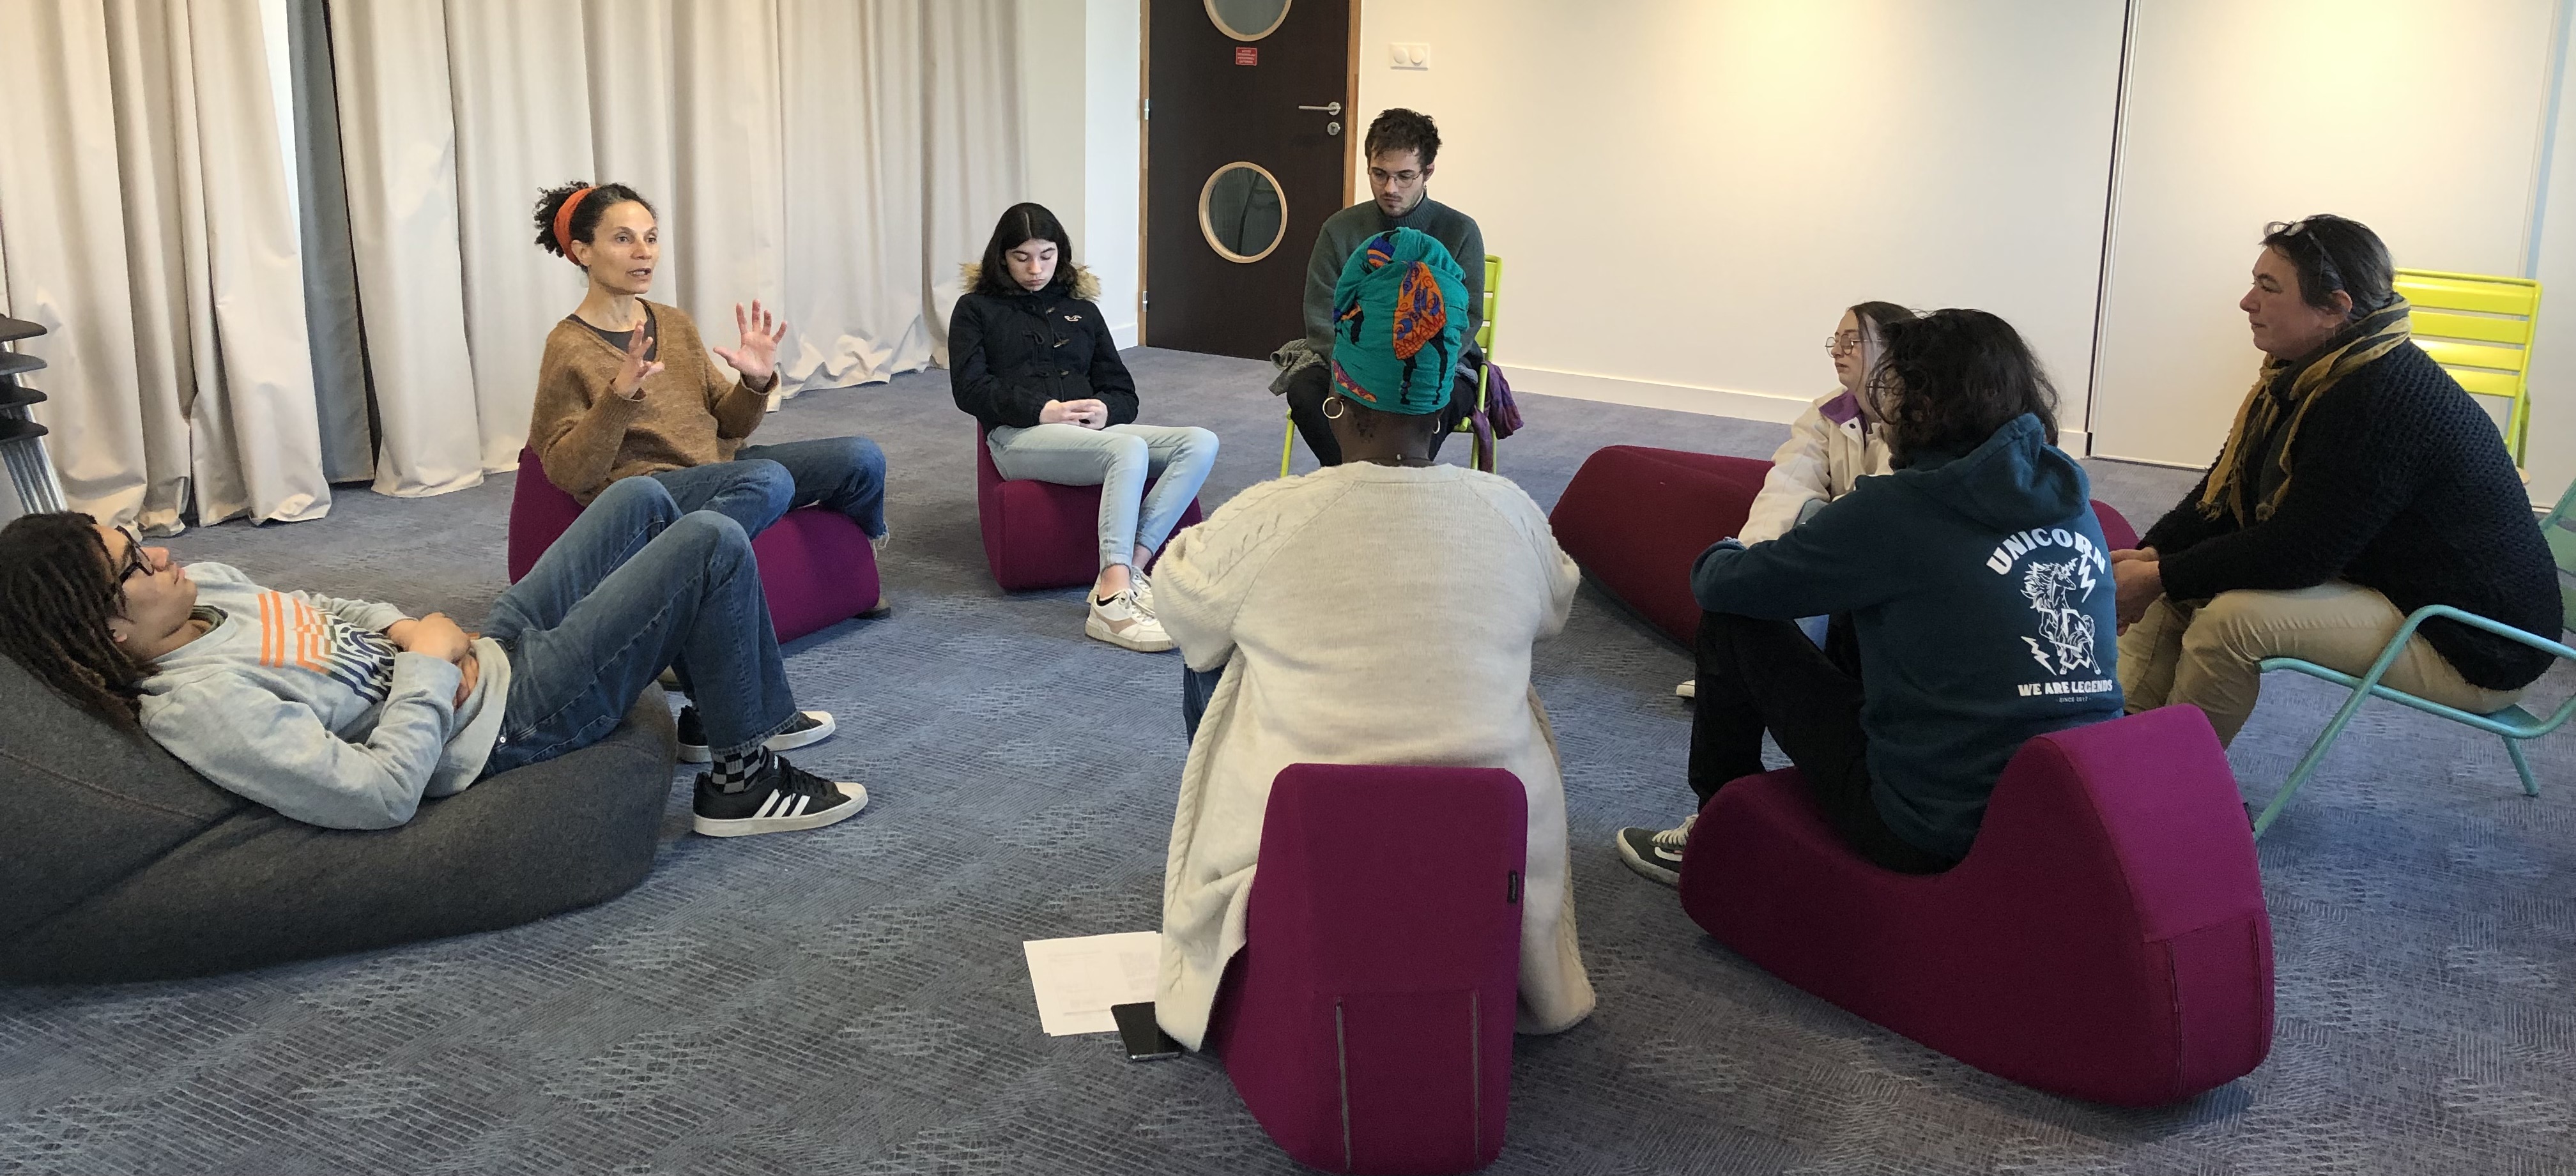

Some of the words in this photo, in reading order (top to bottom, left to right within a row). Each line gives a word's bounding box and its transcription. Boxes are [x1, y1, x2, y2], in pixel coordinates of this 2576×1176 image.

[1986, 528, 2106, 575] UNICORN
[2018, 683, 2042, 696] WE
[2045, 681, 2070, 694] ARE
[2072, 680, 2113, 693] LEGENDS
